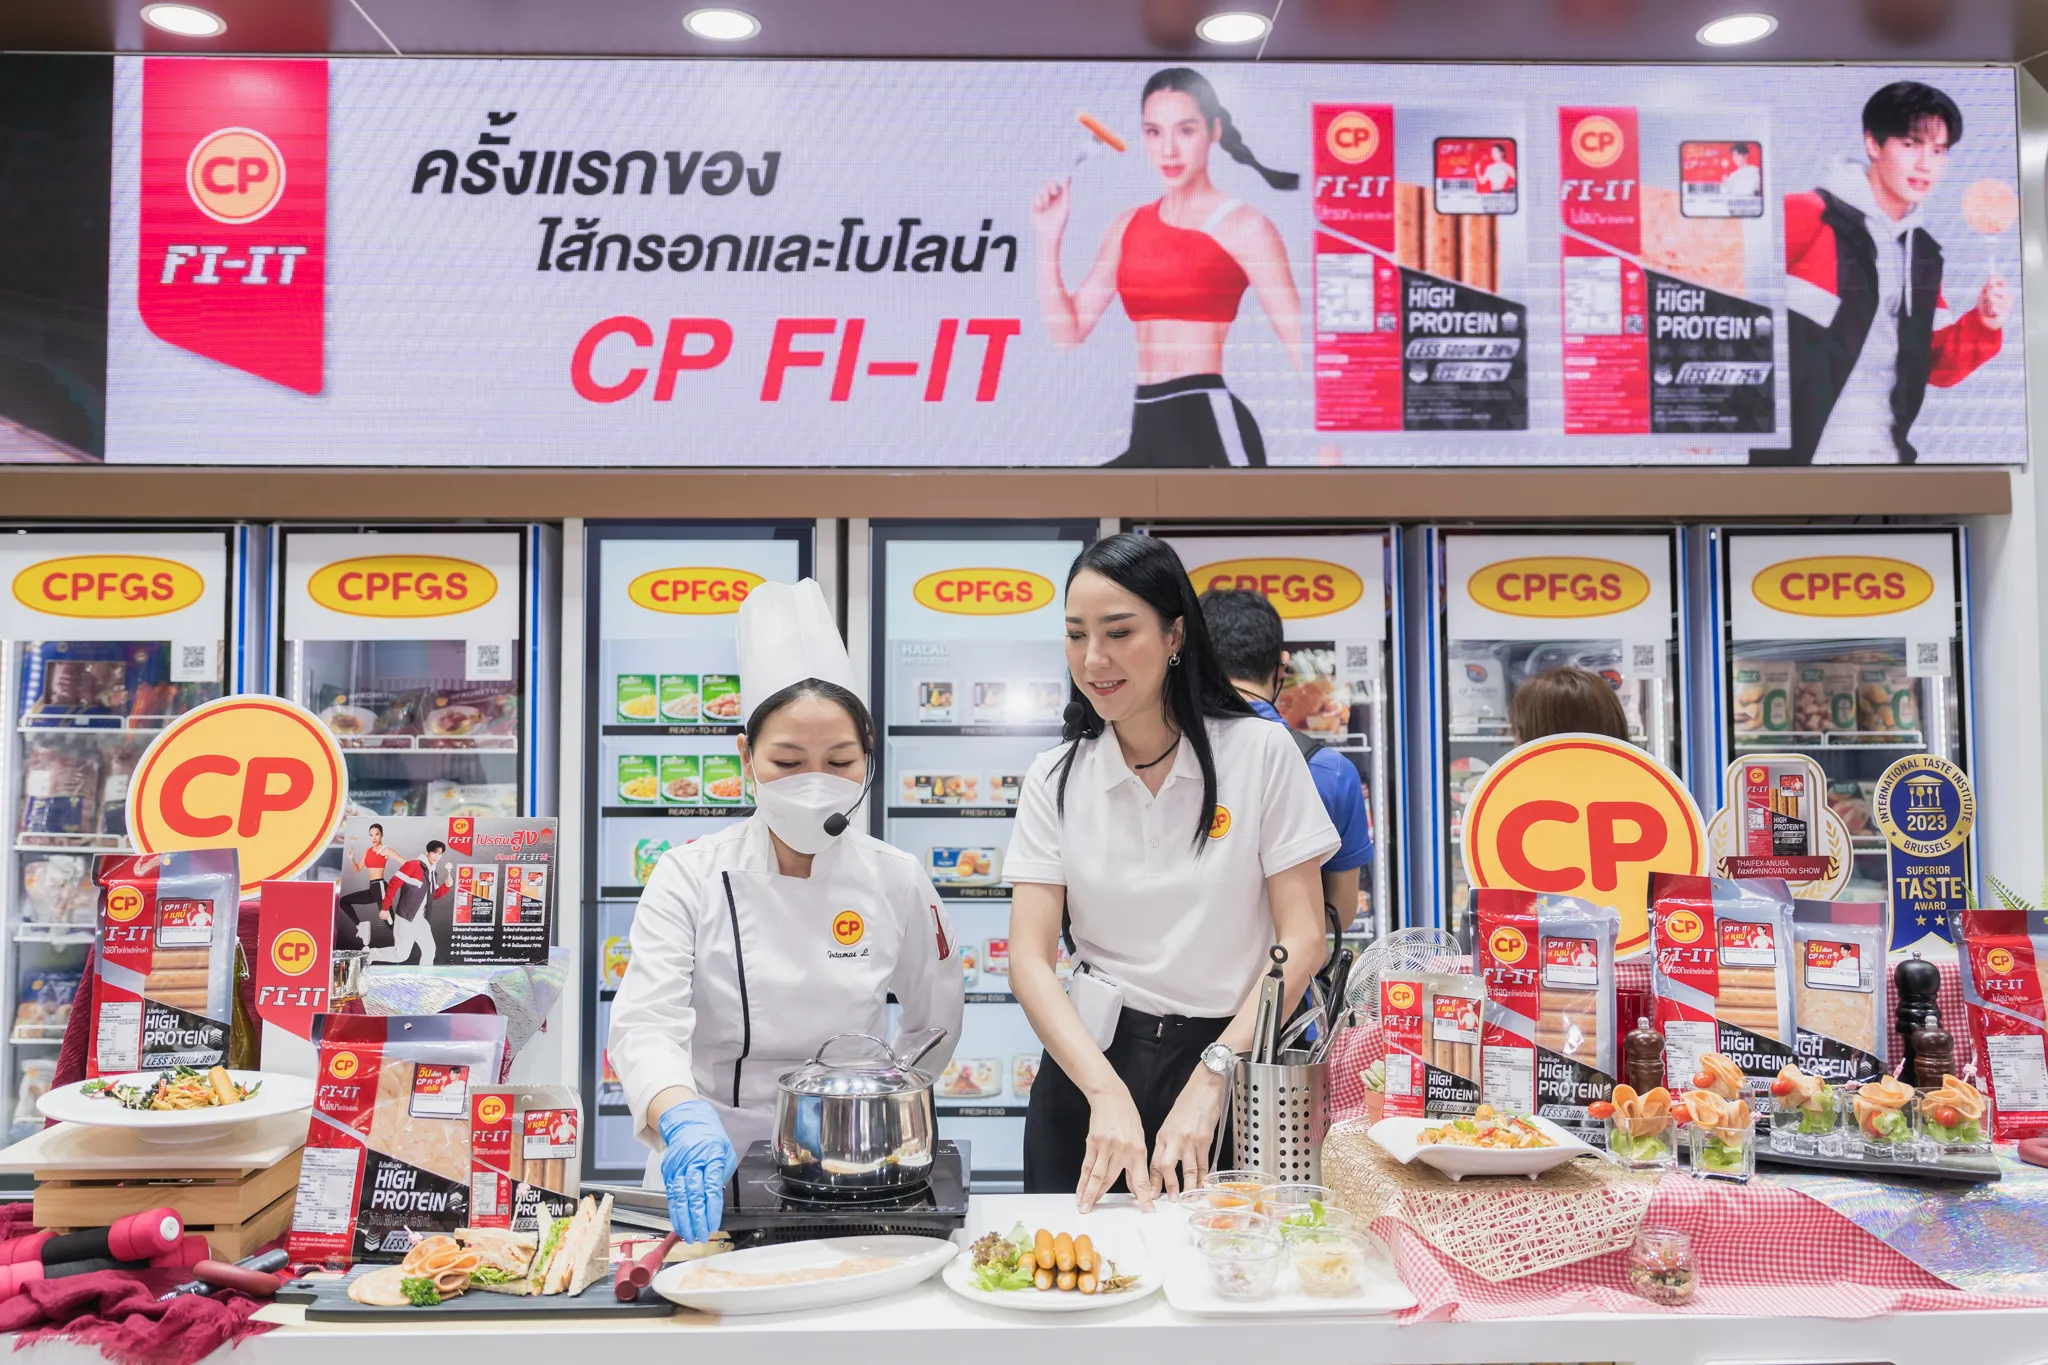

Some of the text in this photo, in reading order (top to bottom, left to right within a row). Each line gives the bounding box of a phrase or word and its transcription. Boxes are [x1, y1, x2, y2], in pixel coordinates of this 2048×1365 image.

[1334, 128, 1370, 148] CP
[1580, 132, 1615, 153] CP
[412, 111, 781, 196] ครั้งแรกของ
[201, 156, 269, 194] CP
[1315, 175, 1391, 198] FI-IT
[1561, 179, 1635, 201] FI-IT
[536, 217, 1018, 273] ไส้กรอกและโบโลน่า
[161, 244, 307, 285] FI-IT
[1408, 287, 1455, 308] HIGH
[1655, 290, 1705, 312] HIGH
[1408, 312, 1498, 334] PROTEIN
[1656, 315, 1752, 340] PROTEIN
[569, 315, 1021, 404] CP FI-IT
[42, 571, 175, 602] CPFGS
[337, 571, 469, 602] CPFGS
[650, 579, 750, 603] CPFGS
[935, 579, 1034, 604] CPFGS
[1496, 572, 1623, 602] CPFGS
[1779, 572, 1906, 601] CPFGS
[902, 644, 948, 656] HALAL
[669, 726, 728, 735] READY-TO-EAT
[159, 754, 315, 839] CP
[1878, 757, 1973, 824] INTERNATIONAL TASTE INSTITUTE
[668, 807, 728, 816] READY-TO-EAT
[961, 808, 1006, 816] FRESH EGG
[1212, 813, 1227, 830] P
[1906, 814, 1947, 831] 2023
[448, 836, 472, 844] FI-IT
[475, 830, 538, 851] โปรตีนสูง
[1496, 799, 1668, 892] CP
[1904, 839, 1952, 854] BRUSSELS
[1736, 859, 1790, 867] THAIFEX-ANUGA
[1906, 866, 1951, 876] SUPERIOR
[960, 888, 1006, 896] FRESH EGG
[1896, 877, 1963, 900] TASTE
[110, 896, 138, 911] CP
[1914, 901, 1947, 911] AWARD
[105, 926, 152, 942] I-IT
[836, 920, 860, 936] CP
[1671, 920, 1697, 933] CP
[278, 943, 310, 962] CP
[1495, 937, 1521, 953] CP
[1659, 947, 1714, 963] FI-IT
[1991, 956, 2010, 966] CP
[1483, 968, 1538, 984] FI-IT
[1985, 979, 2024, 990] FI-IT
[258, 985, 326, 1008] FI-IT
[965, 993, 1006, 1002] RESH EGG
[1392, 991, 1410, 1002] CP
[145, 1014, 180, 1030] HIGH
[1383, 1015, 1421, 1027] FI-IT
[144, 1029, 209, 1046] PROTEIN
[1721, 1035, 1754, 1052] HIGH
[1800, 1038, 1823, 1056] GH
[146, 1056, 169, 1066] LESS
[169, 1055, 199, 1065] SODIUM
[334, 1059, 354, 1071] CP
[1798, 1056, 1858, 1078] ROTEIN
[1538, 1062, 1572, 1079] HIGH
[1428, 1074, 1453, 1086] HIGH
[1751, 1081, 1771, 1089] SODI
[318, 1085, 360, 1098] FI-IT
[1428, 1087, 1473, 1101] PROTEIN
[1538, 1080, 1603, 1099] PROTEIN
[482, 1105, 501, 1116] CP
[960, 1106, 1006, 1115] FRESH EGG
[1445, 1104, 1467, 1112] SODIUM
[1542, 1108, 1584, 1119] LESS SODI
[472, 1130, 510, 1142] FI-IT
[375, 1169, 417, 1190] HIGH
[371, 1189, 448, 1212] PROTEIN
[517, 1203, 564, 1216] PROEIN
[514, 1220, 533, 1228] LESS
[382, 1238, 408, 1250] LESS
